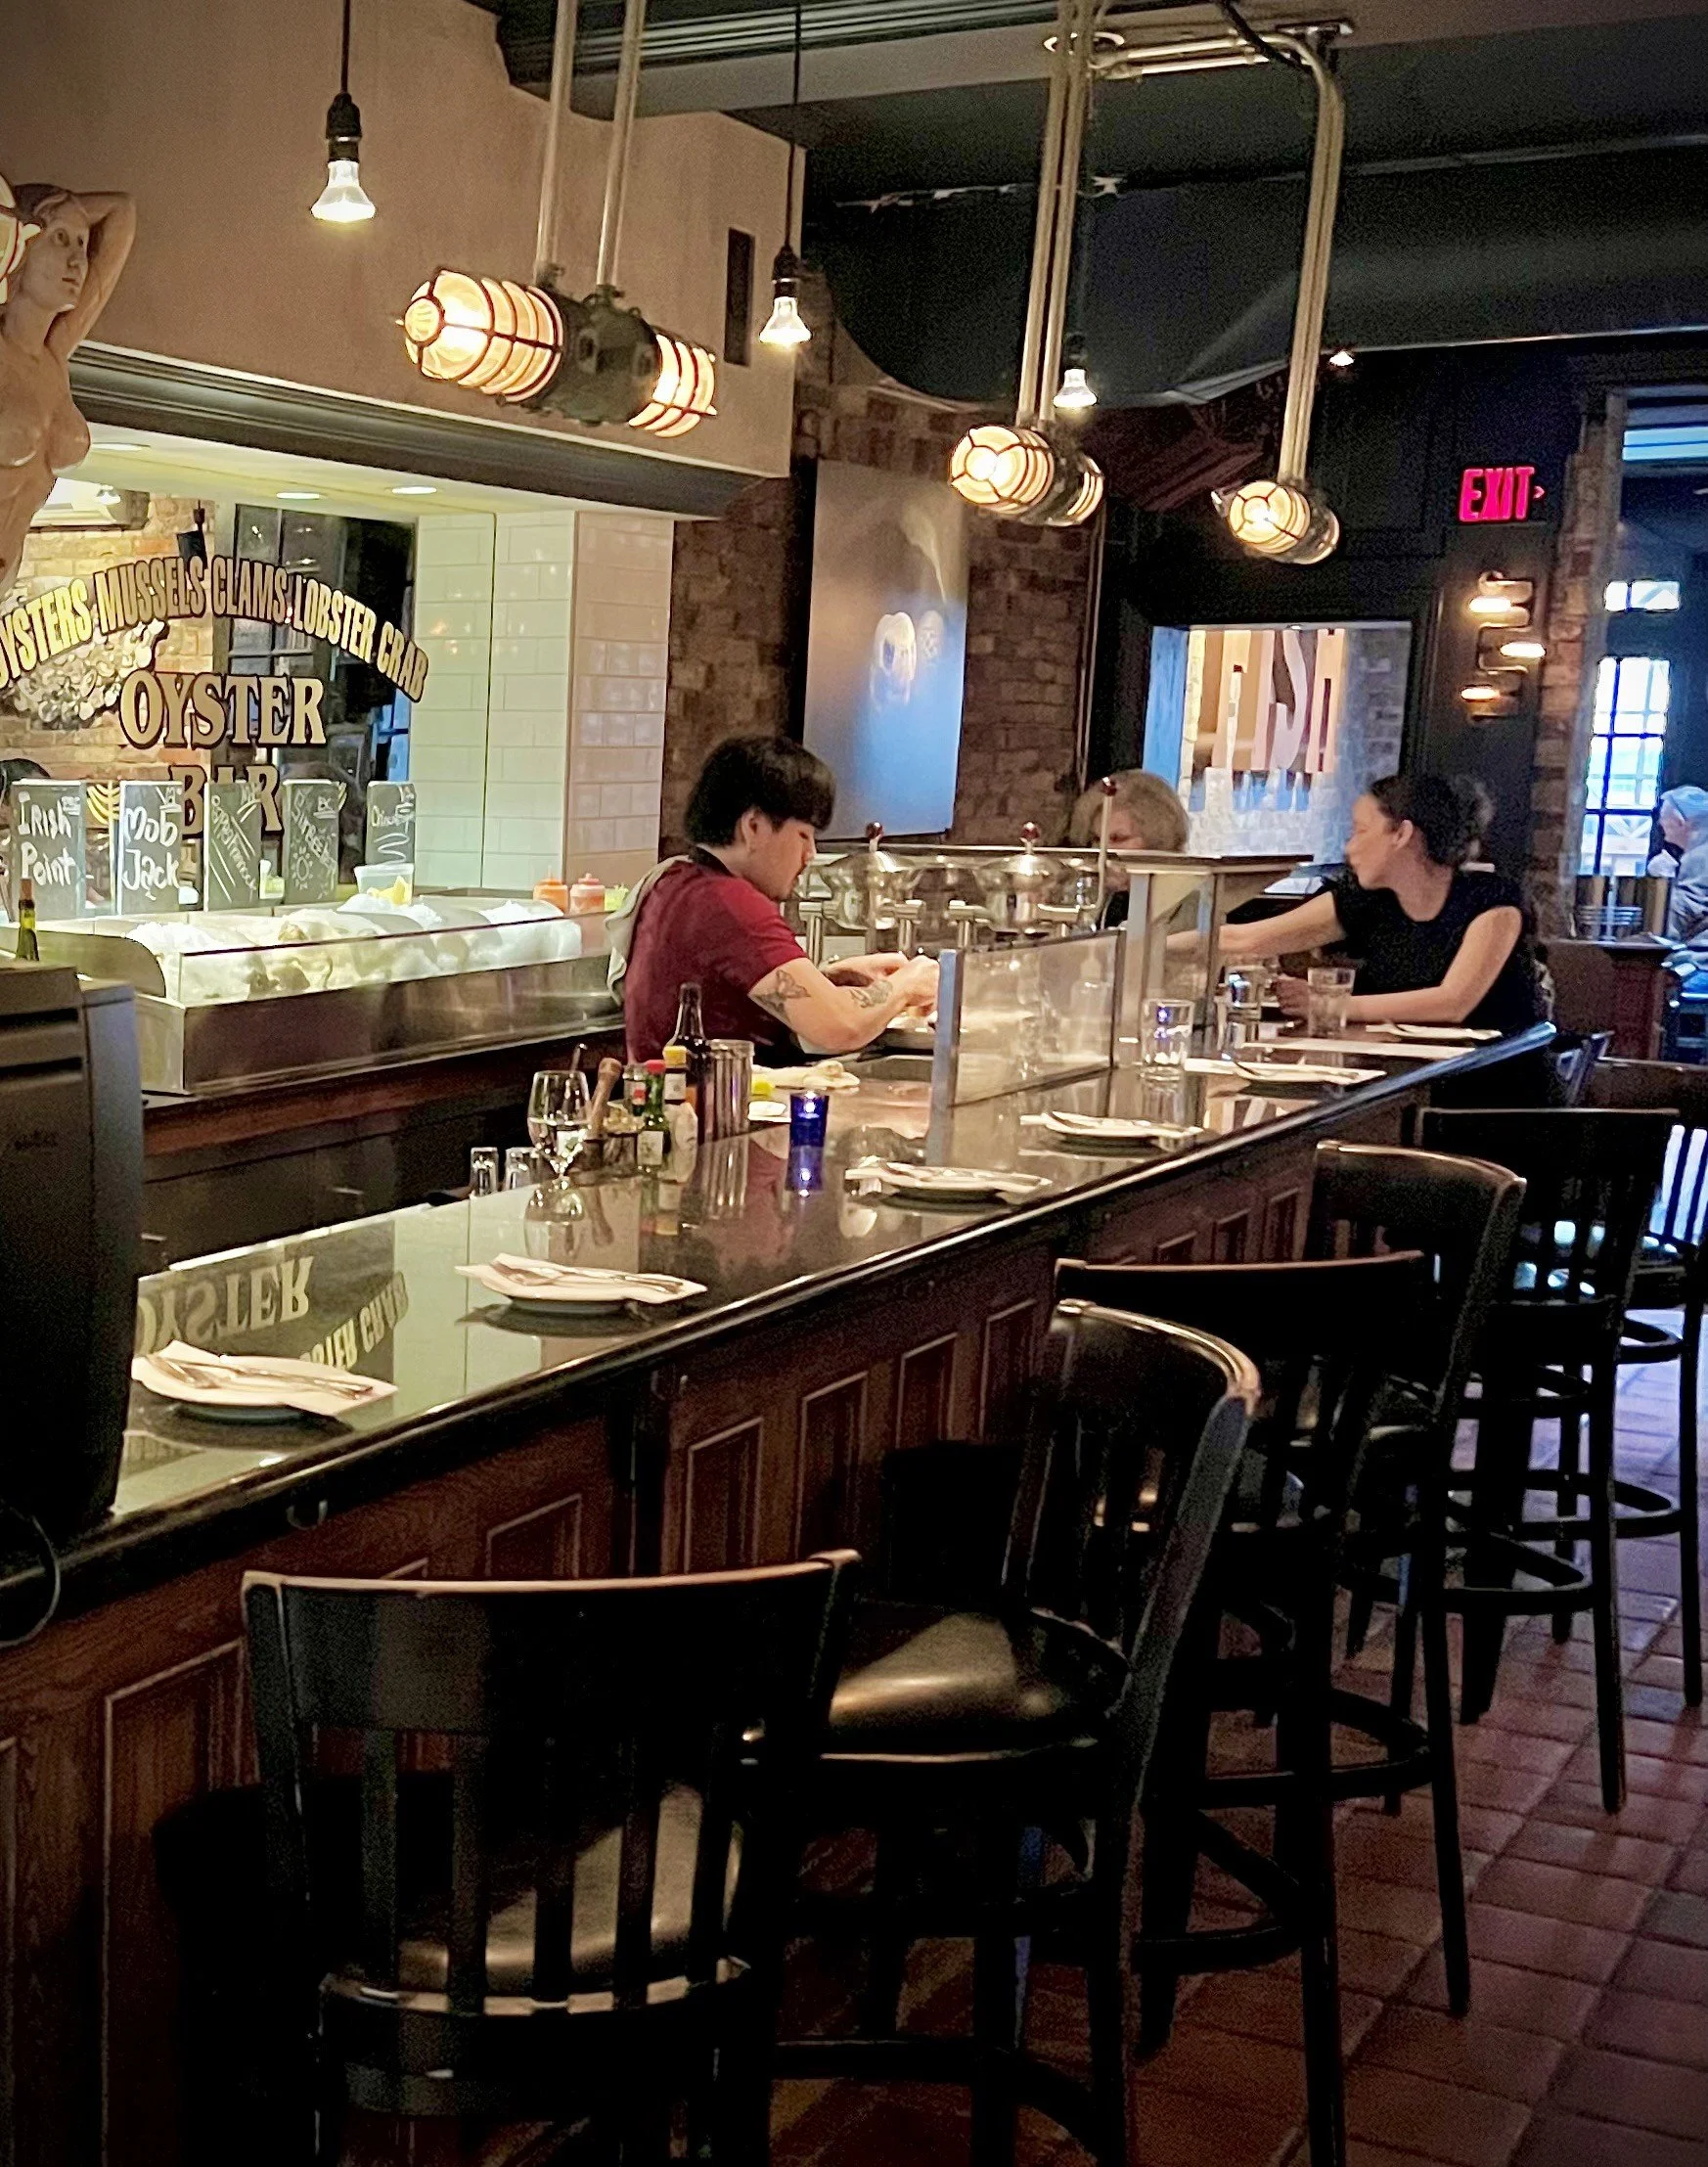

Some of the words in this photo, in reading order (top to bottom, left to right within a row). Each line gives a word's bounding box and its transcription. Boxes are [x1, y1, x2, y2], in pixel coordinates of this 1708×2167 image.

[1460, 467, 1535, 521] EXIT
[0, 578, 93, 688] YSTERS
[93, 555, 206, 636] MUSSELS
[211, 554, 287, 624] CLAMS
[292, 573, 378, 665] LOBSTER
[376, 620, 429, 703] CRAB
[119, 670, 327, 749] OYSTER
[167, 764, 285, 837] BR
[21, 841, 76, 886] Point
